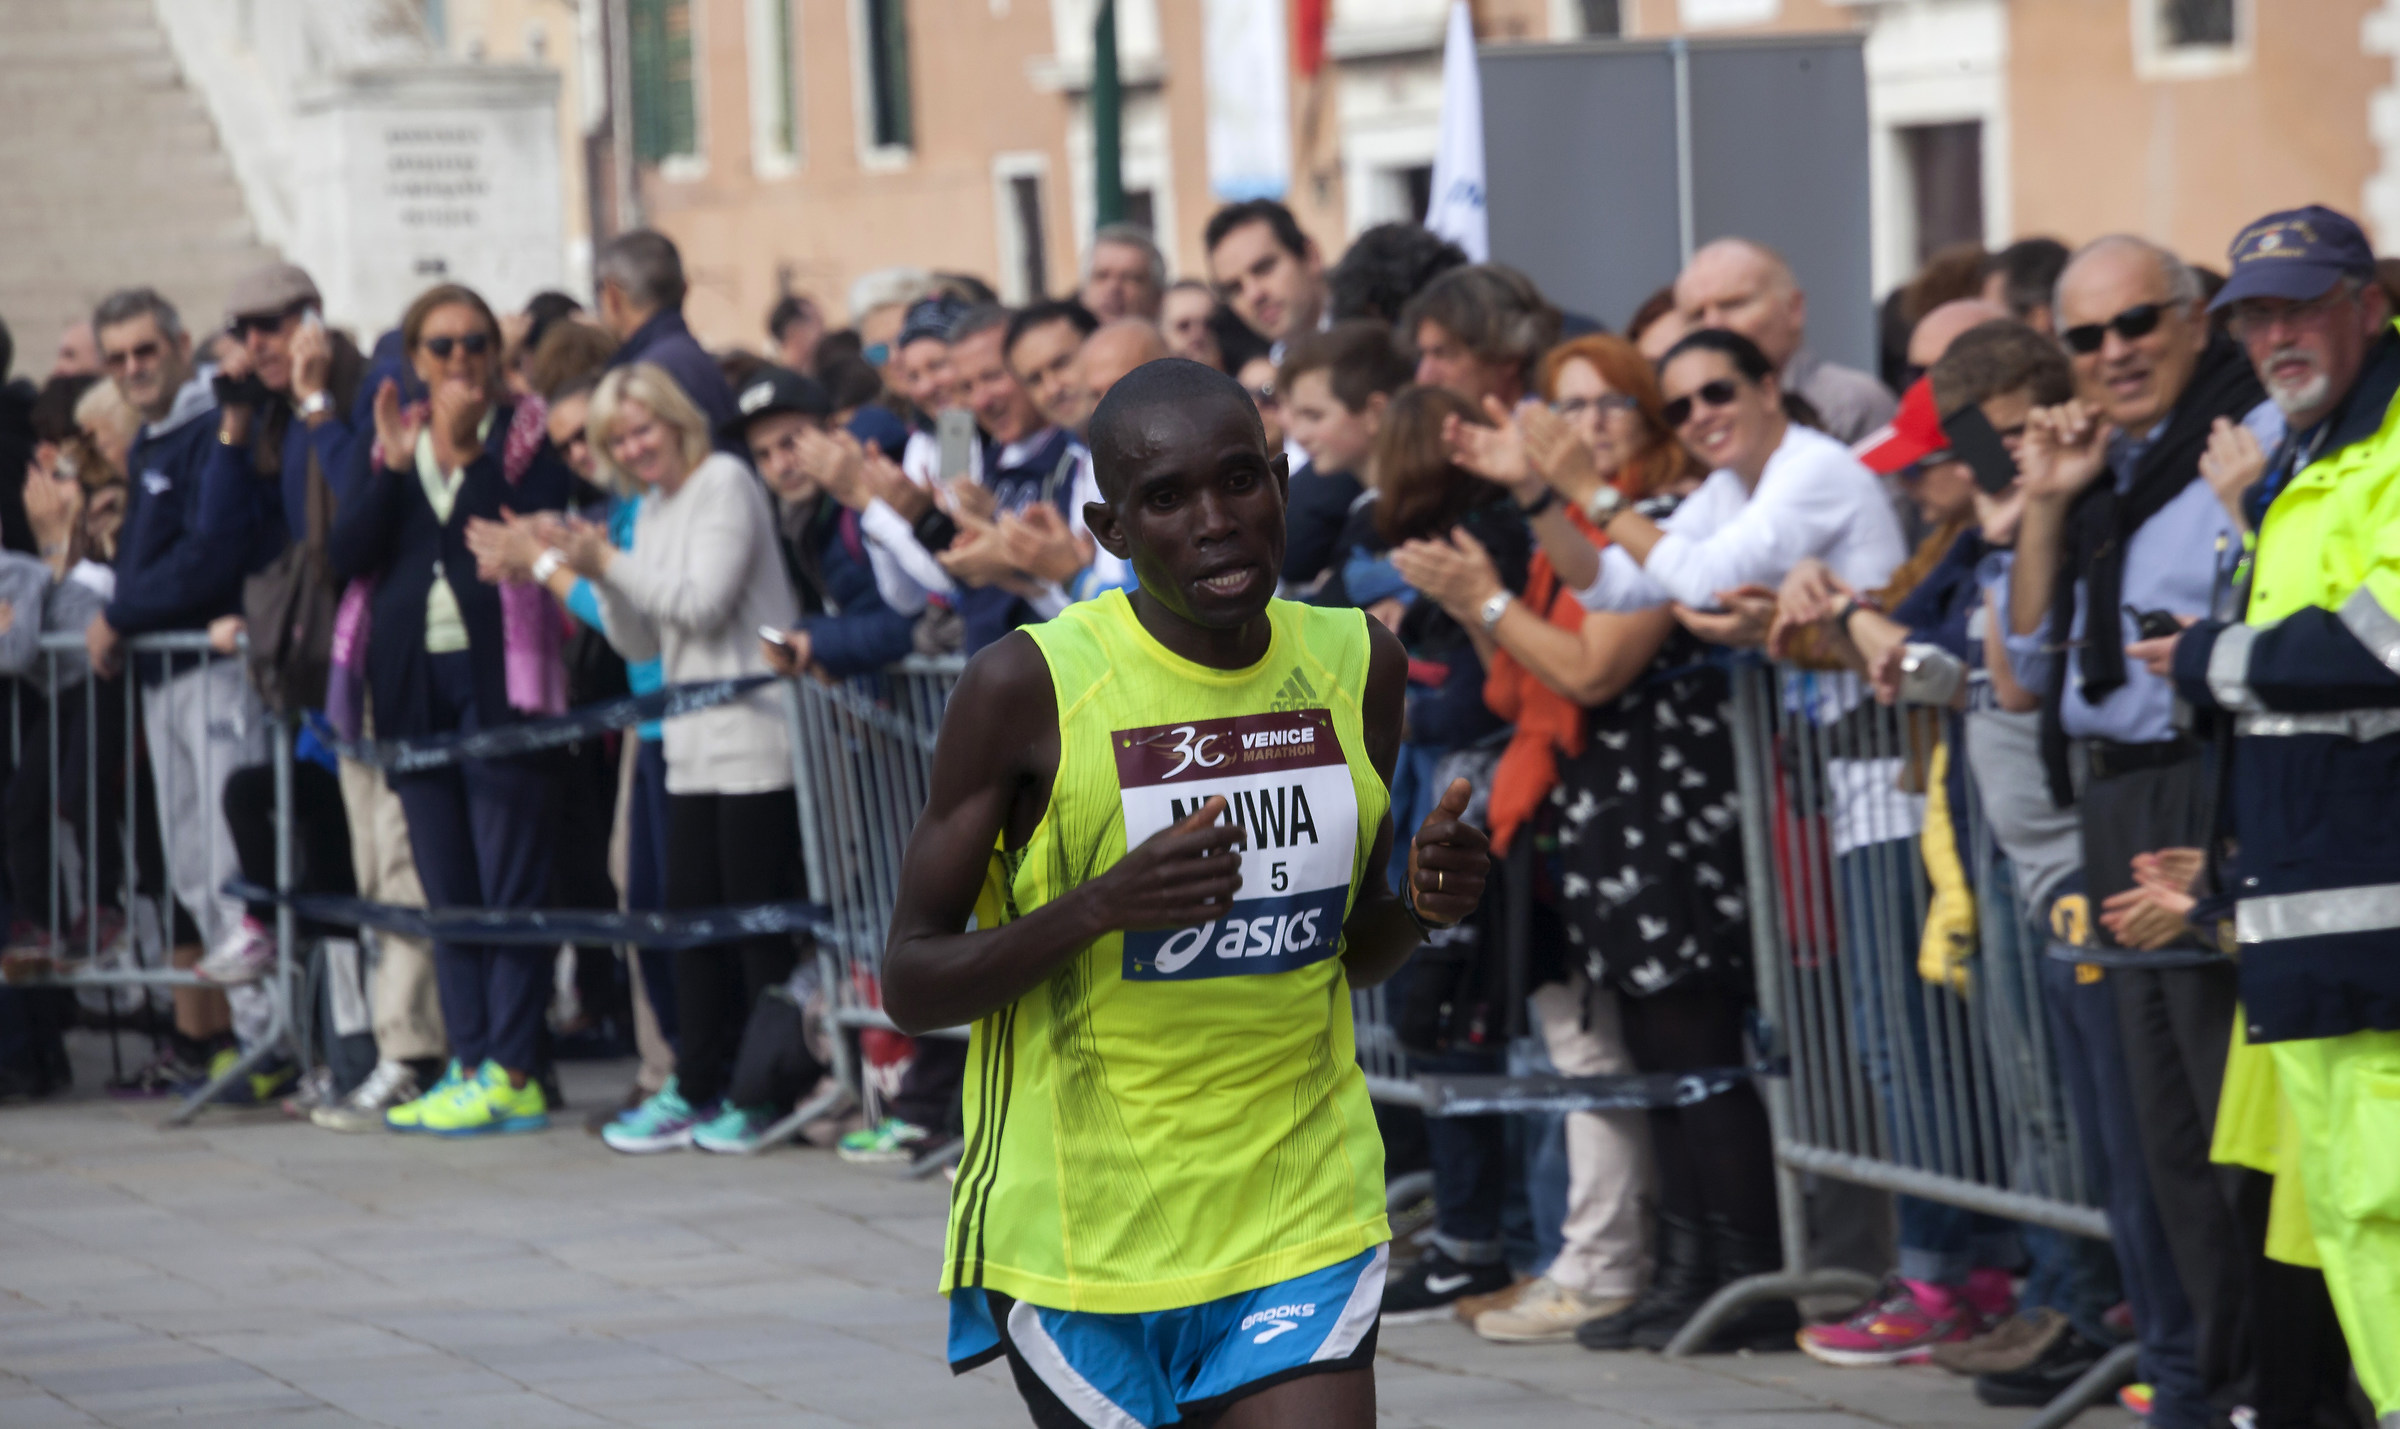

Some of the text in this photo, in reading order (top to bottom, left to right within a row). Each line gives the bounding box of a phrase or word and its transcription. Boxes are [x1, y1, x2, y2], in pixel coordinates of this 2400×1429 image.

[1270, 697, 1325, 712] adid
[1241, 727, 1315, 750] VENICE
[1243, 744, 1315, 763] MARATHON
[1270, 861, 1289, 892] 5
[1215, 907, 1323, 959] asics
[1241, 1303, 1316, 1331] BROOKS
